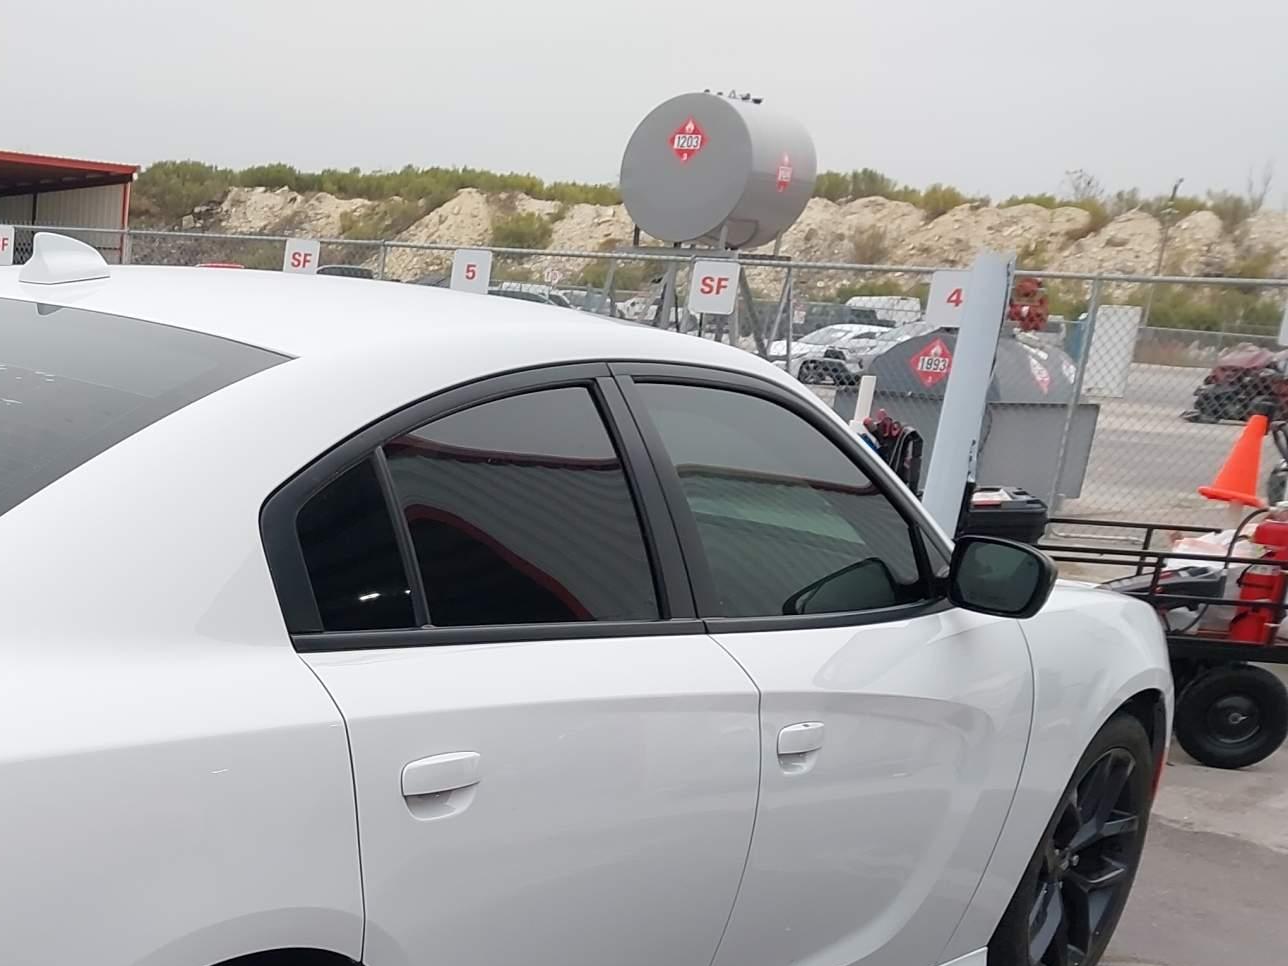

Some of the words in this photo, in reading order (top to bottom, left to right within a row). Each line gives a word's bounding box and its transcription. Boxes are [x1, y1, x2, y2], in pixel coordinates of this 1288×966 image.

[676, 135, 700, 149] 1203
[291, 251, 312, 268] SF
[465, 264, 477, 280] 5
[700, 276, 729, 296] SF
[946, 288, 964, 307] 4
